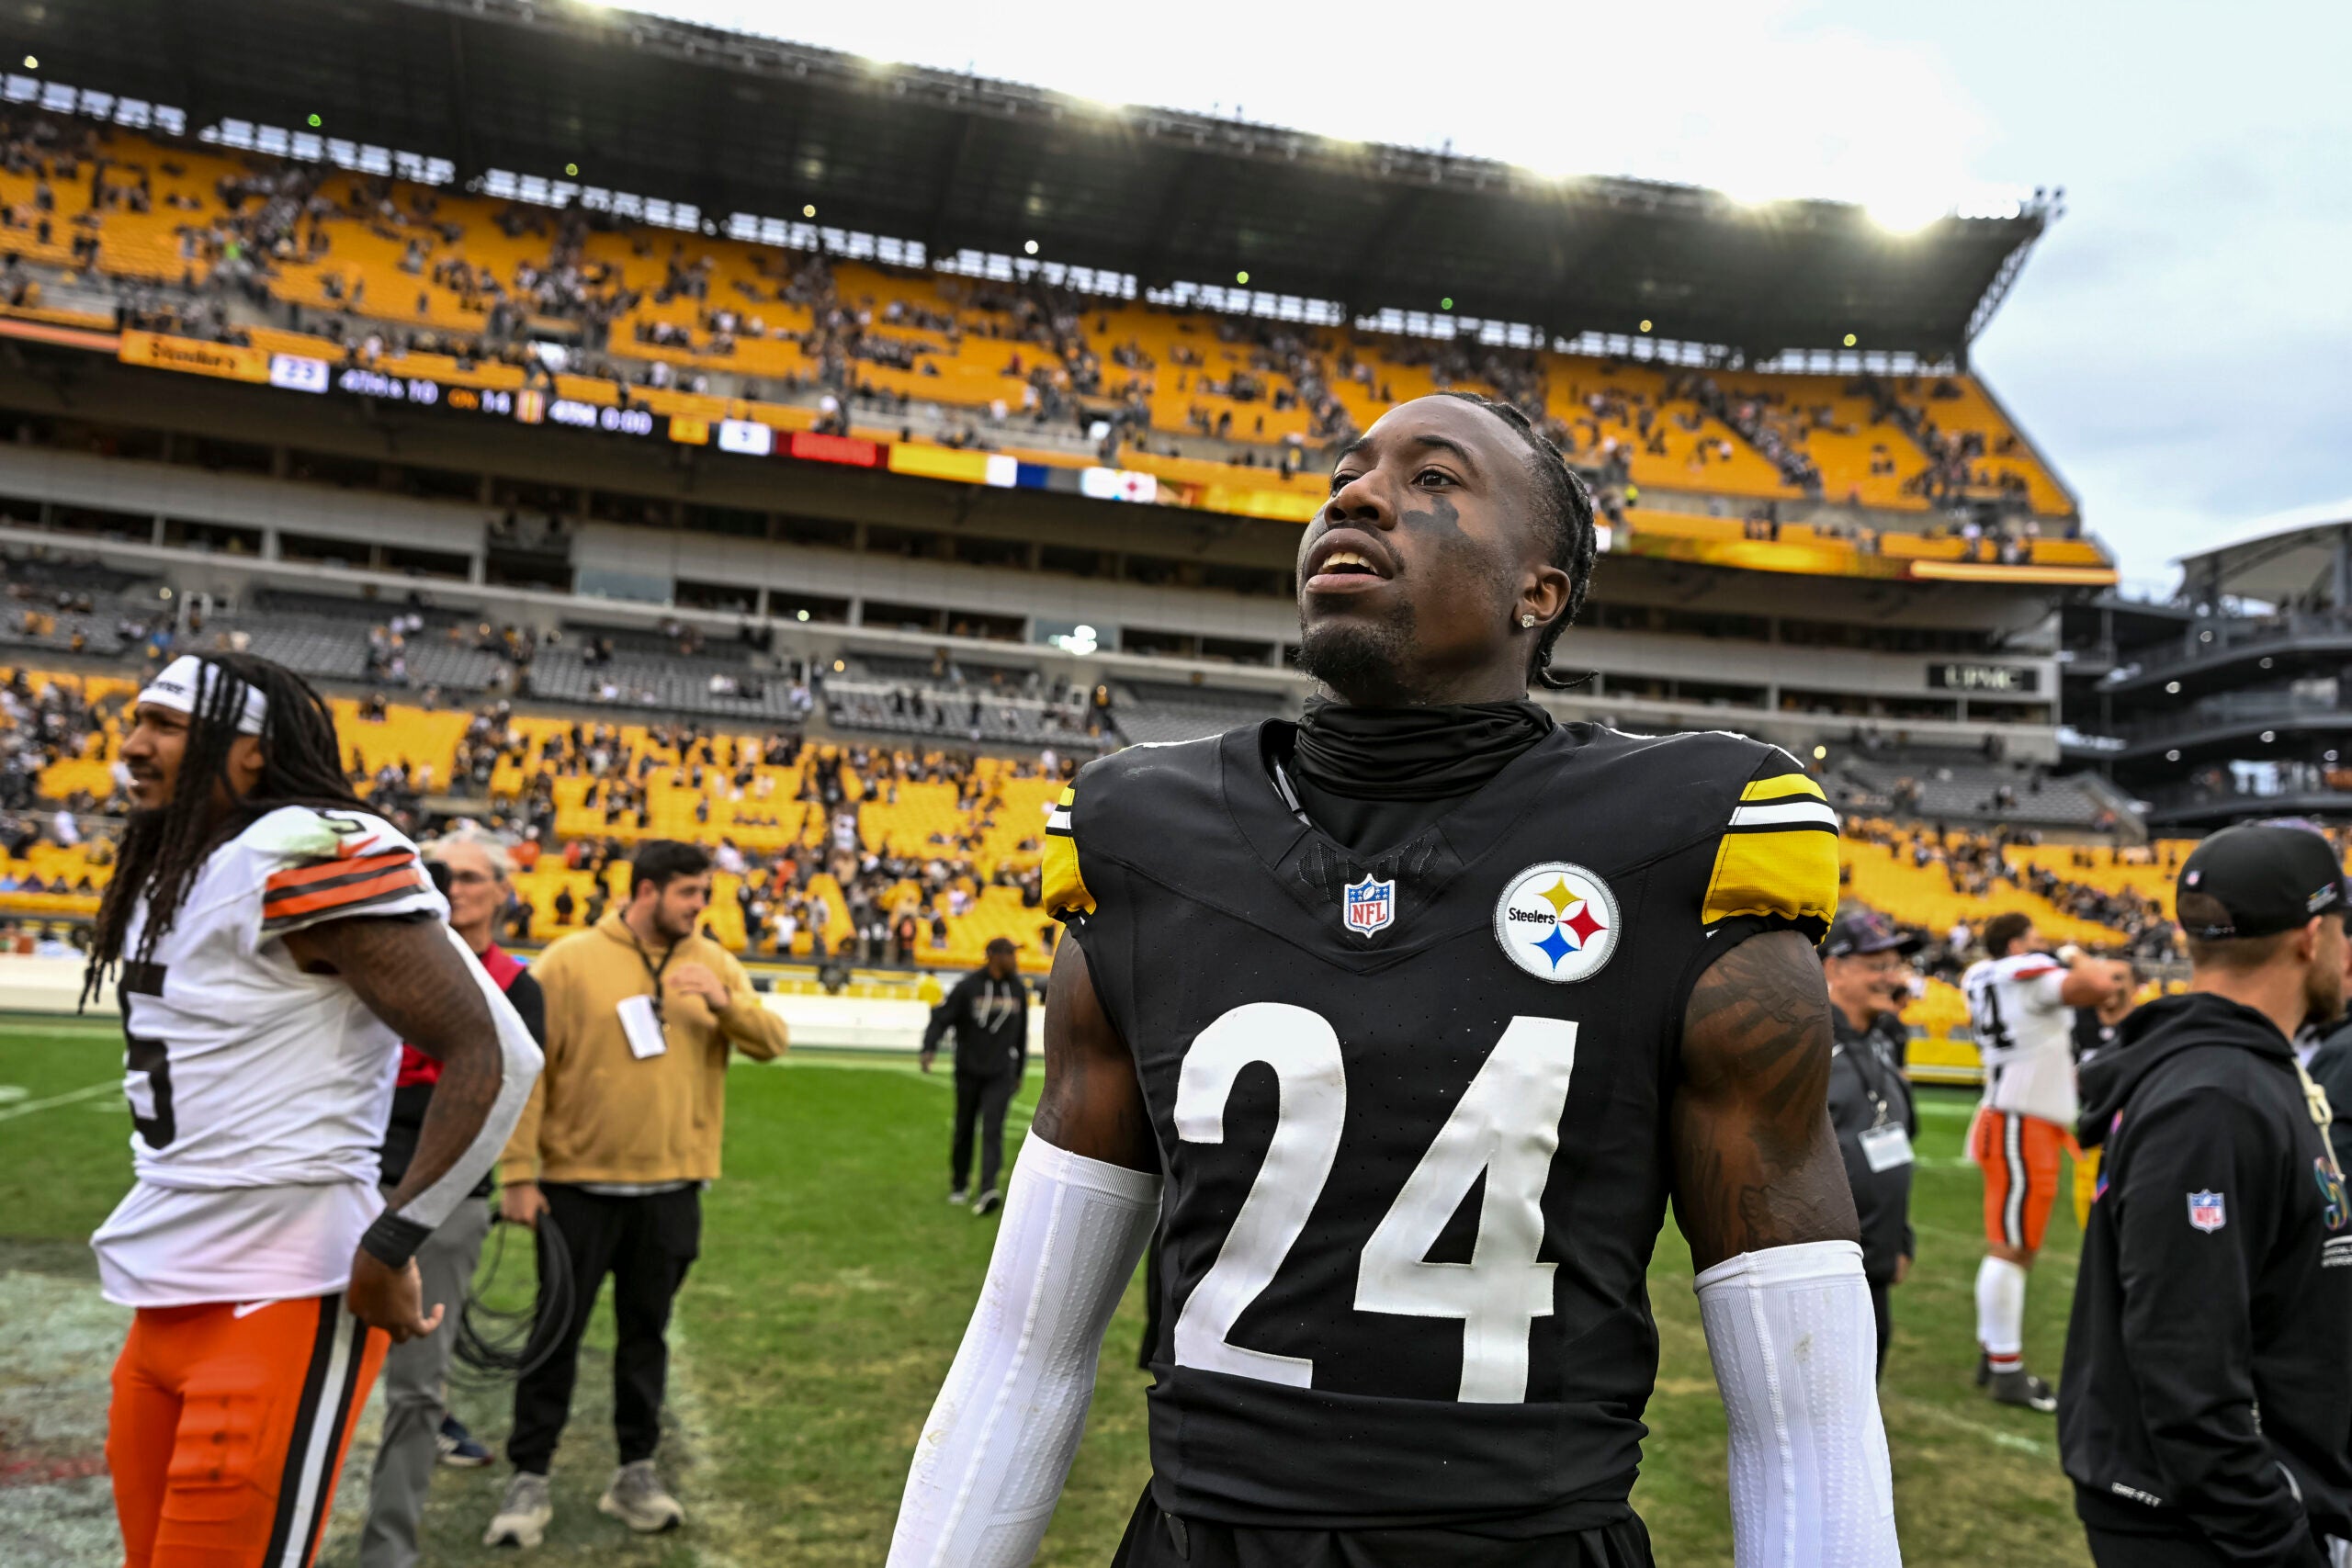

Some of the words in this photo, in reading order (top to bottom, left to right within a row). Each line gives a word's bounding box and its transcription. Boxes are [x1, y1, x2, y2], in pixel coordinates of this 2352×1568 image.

[1351, 902, 1386, 926] NFL
[1509, 907, 1555, 925] Steelers
[119, 961, 175, 1150] 5
[1174, 1001, 1578, 1404] 24
